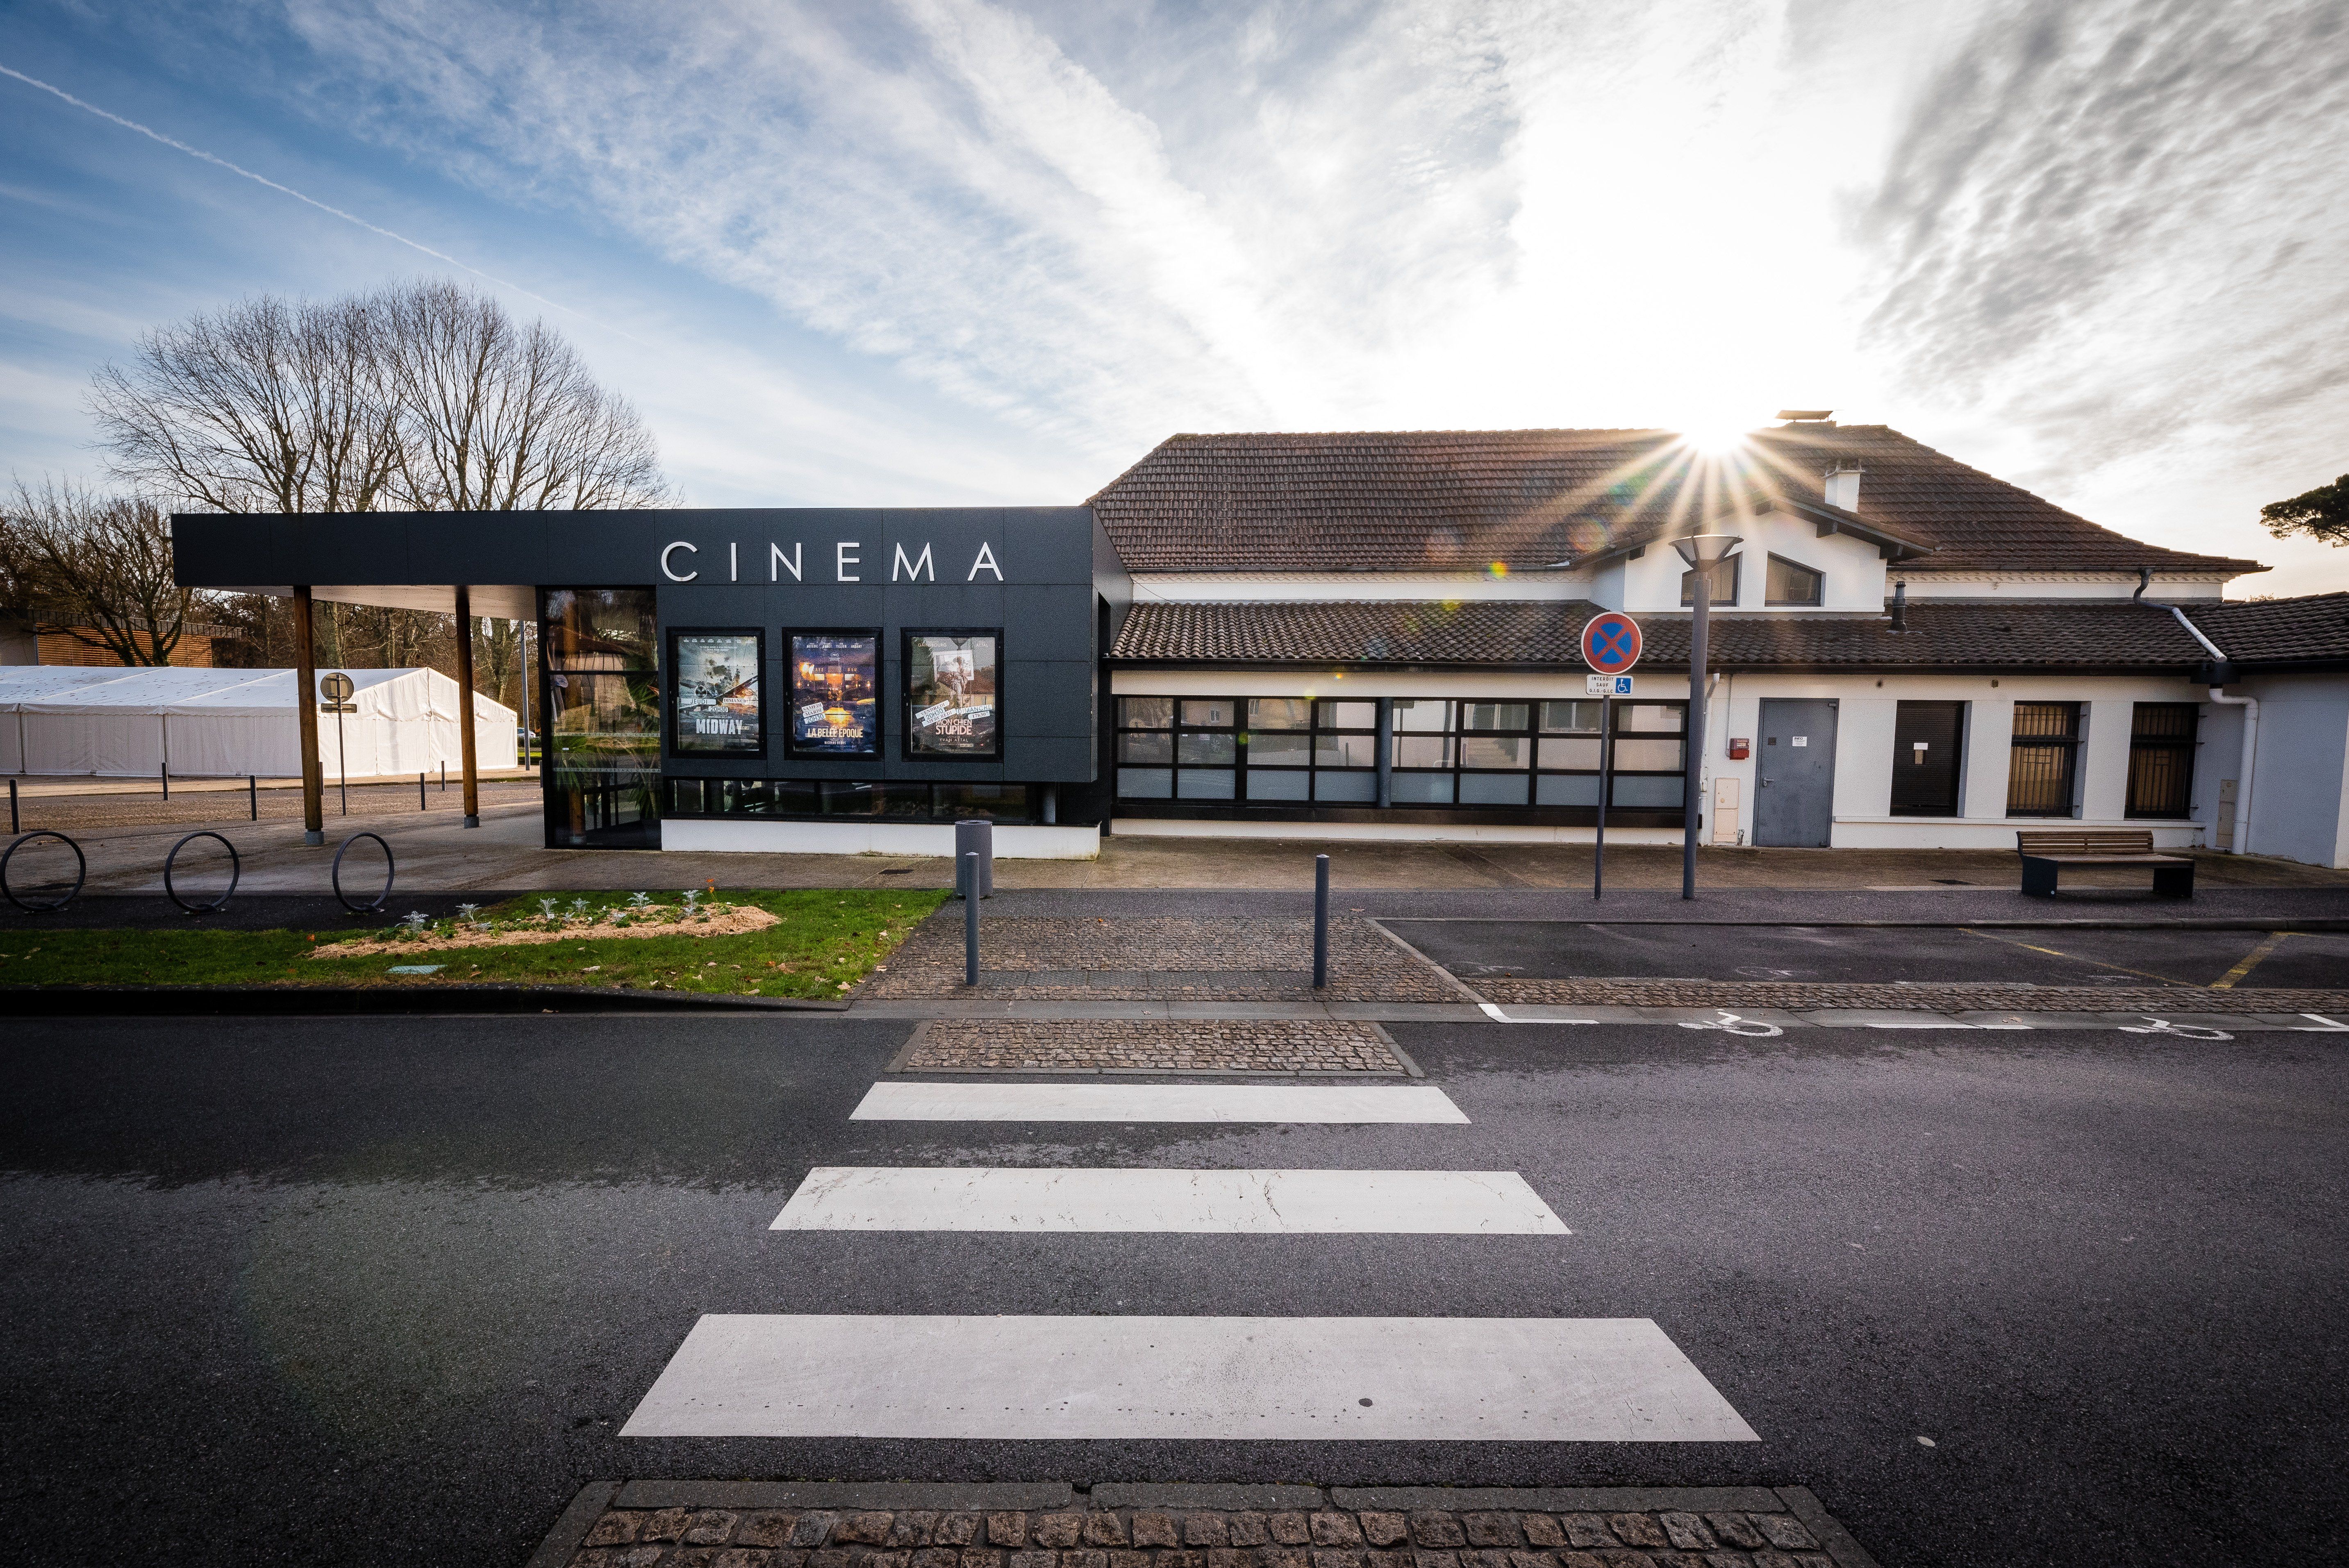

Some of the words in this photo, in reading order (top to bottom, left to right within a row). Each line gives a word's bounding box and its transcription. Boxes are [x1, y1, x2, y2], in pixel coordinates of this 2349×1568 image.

[661, 541, 1003, 582] CINEMA
[803, 703, 822, 711] SAMEDI
[921, 702, 945, 716] VENDREDI
[958, 705, 991, 714] DIMANCHE
[807, 714, 824, 723] 20H30
[926, 708, 943, 720] 20H30
[927, 711, 952, 724] MERCREDI
[696, 718, 743, 734] MIDWAY
[935, 725, 972, 735] STUPIDE
[808, 728, 817, 738] LA
[817, 728, 837, 738] BELLE
